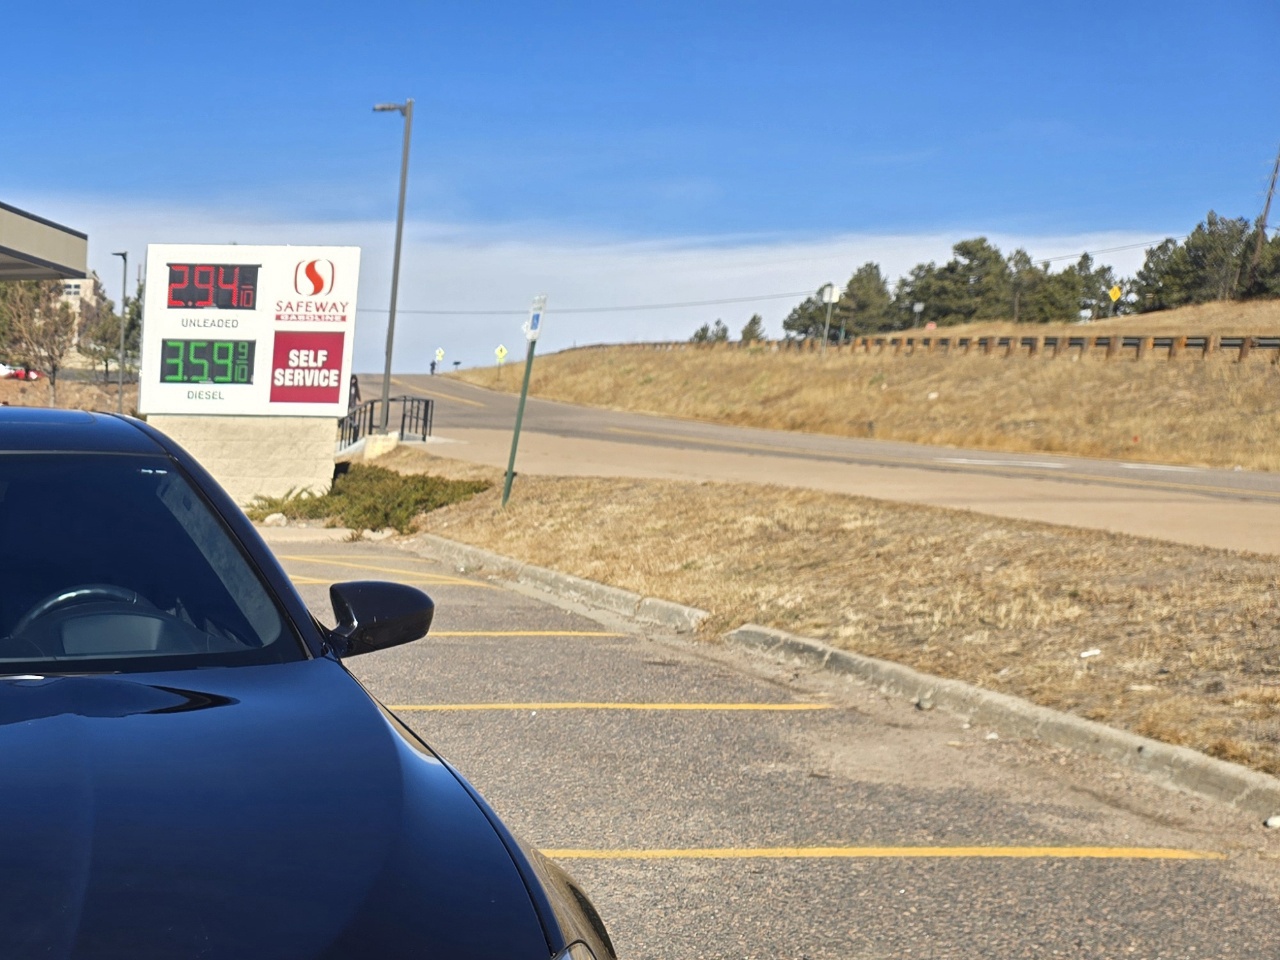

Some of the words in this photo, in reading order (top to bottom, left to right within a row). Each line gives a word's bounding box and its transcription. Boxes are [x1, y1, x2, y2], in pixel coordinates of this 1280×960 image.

[167, 265, 239, 307] 2.94
[275, 300, 349, 313] SAFEWAY
[181, 318, 239, 329] UNLEADED
[288, 349, 328, 368] SELF
[273, 368, 340, 388] SERVICE
[187, 390, 225, 401] DIESEL
